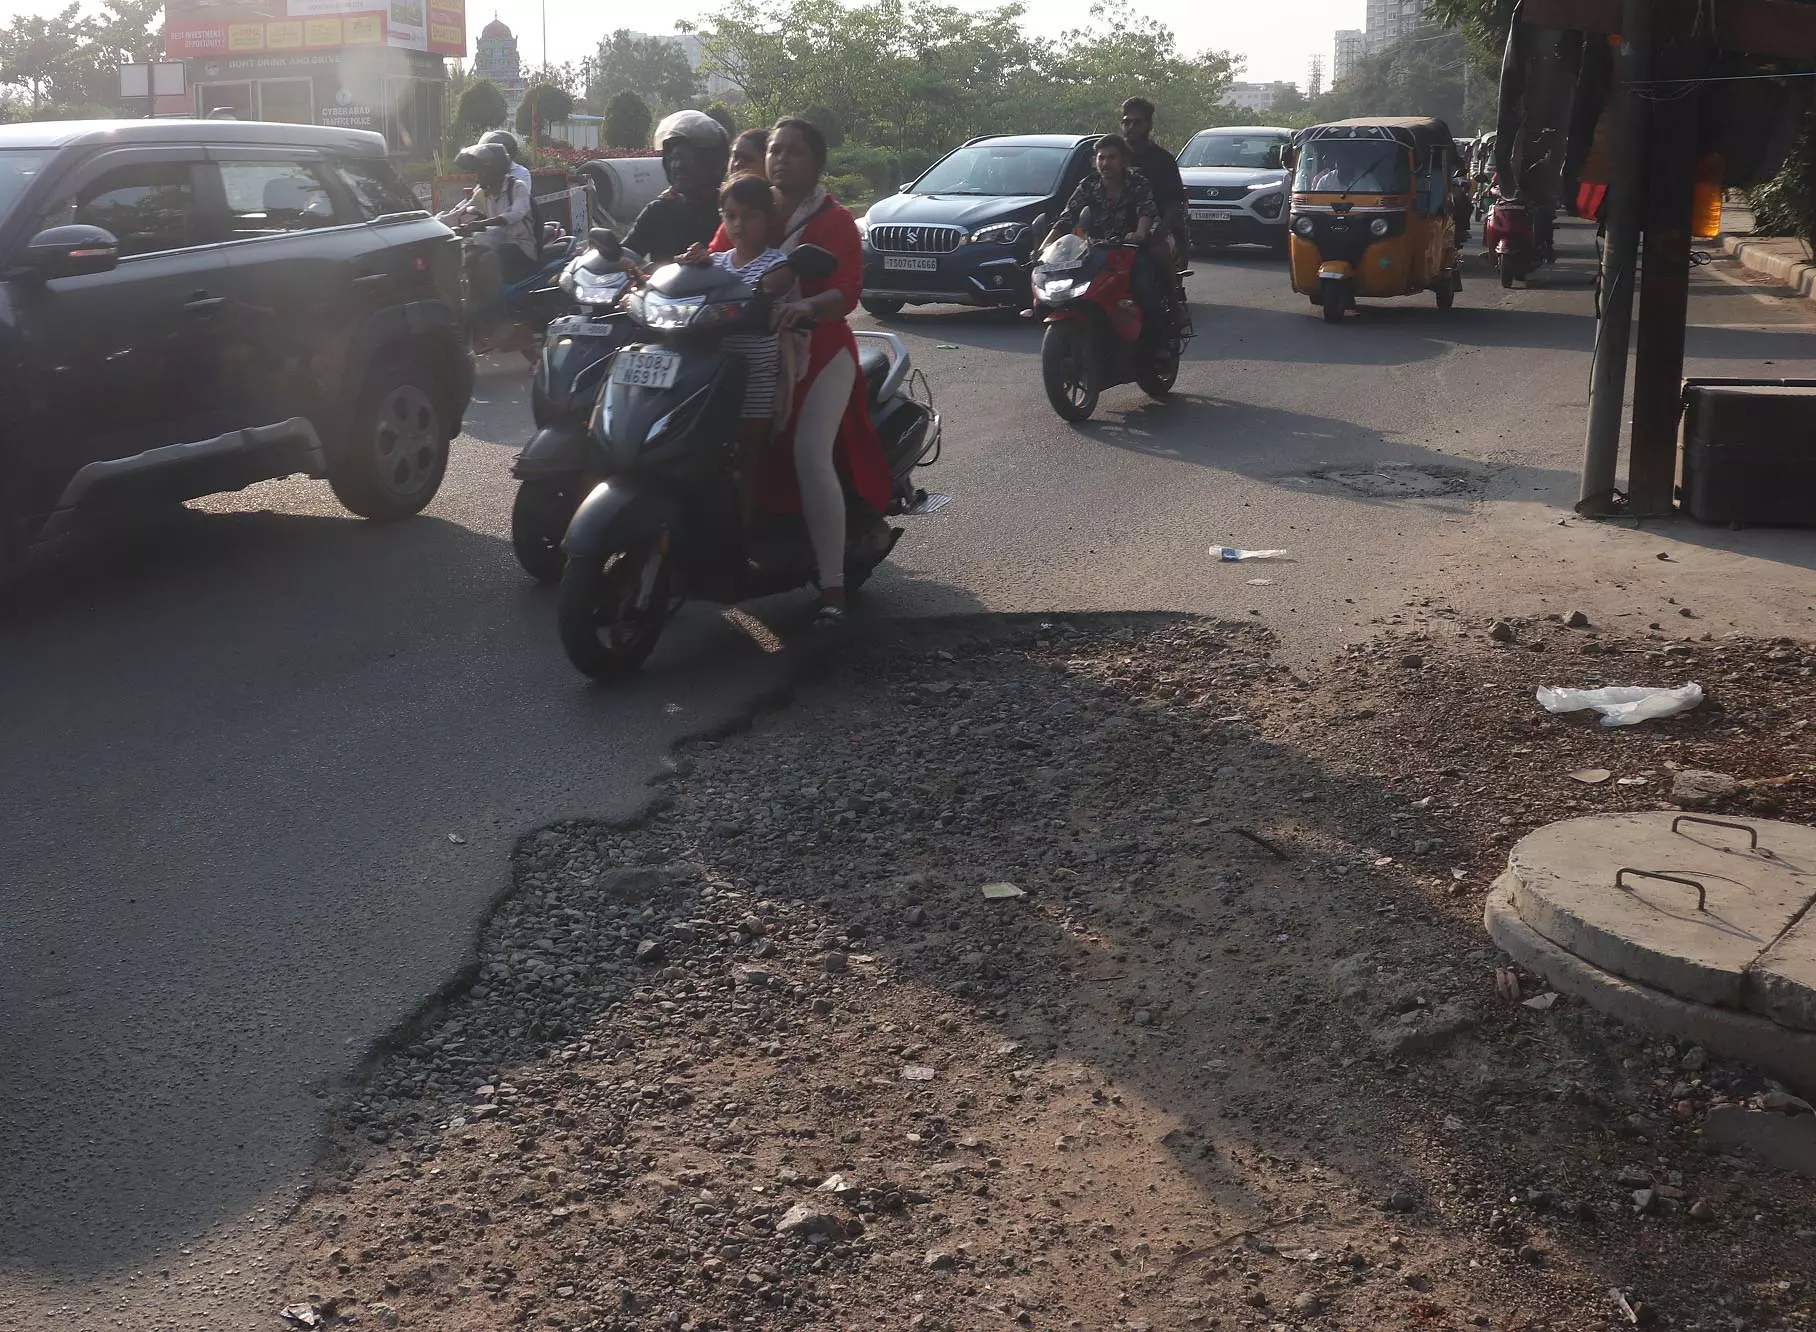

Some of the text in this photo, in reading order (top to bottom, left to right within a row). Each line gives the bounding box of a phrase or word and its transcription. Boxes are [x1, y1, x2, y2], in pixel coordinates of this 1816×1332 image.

[257, 58, 287, 68] DRINK
[289, 56, 309, 65] AND
[311, 55, 340, 64] DRIVE
[321, 106, 370, 116] CYBERABAD
[322, 116, 371, 125] TRAFFIC POLICE
[630, 354, 673, 371] TS08J
